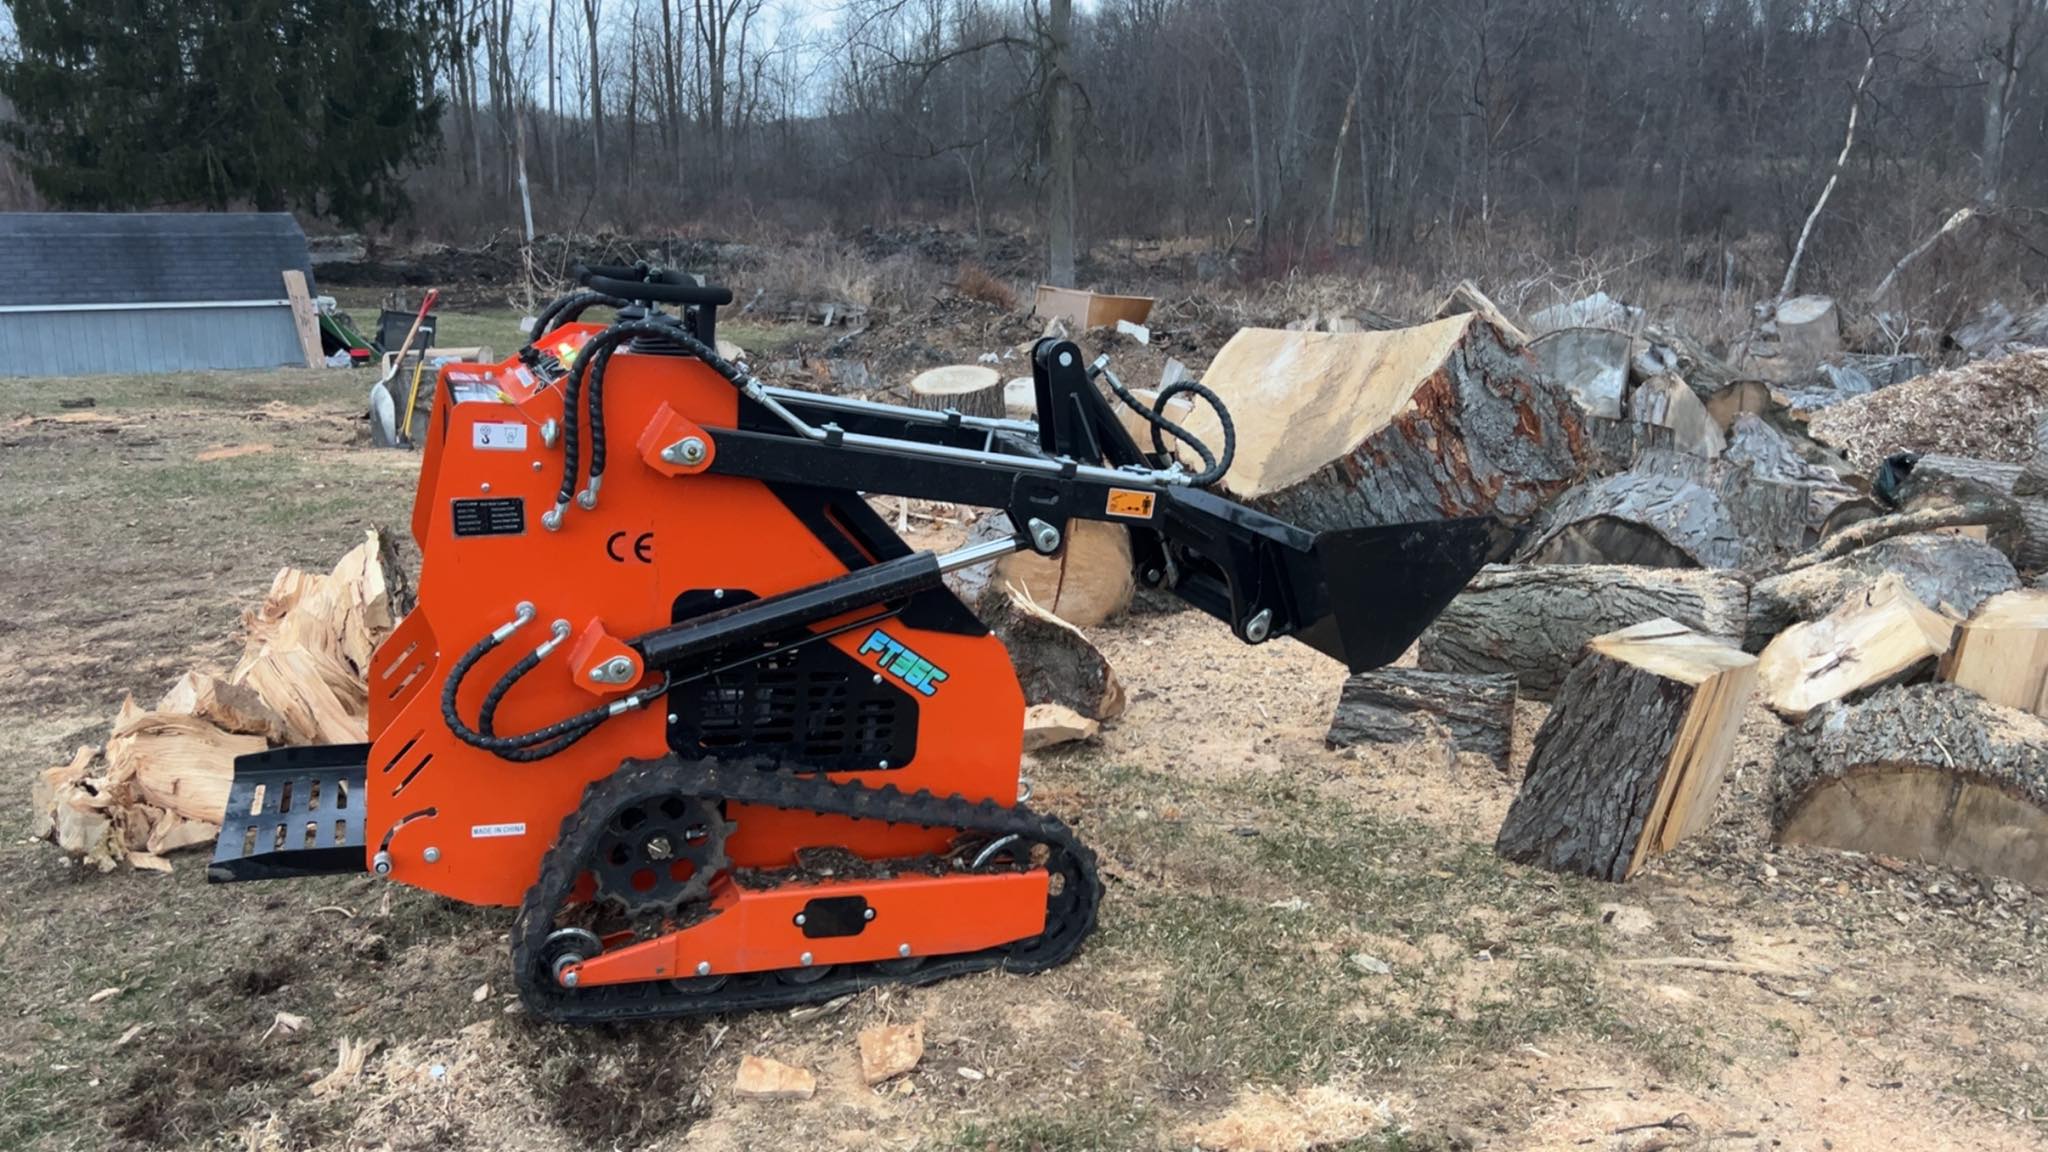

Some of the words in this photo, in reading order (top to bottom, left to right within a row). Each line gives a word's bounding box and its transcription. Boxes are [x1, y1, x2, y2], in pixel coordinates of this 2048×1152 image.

[606, 531, 654, 564] CE
[473, 826, 491, 835] MADE
[503, 825, 524, 833] CHINA
